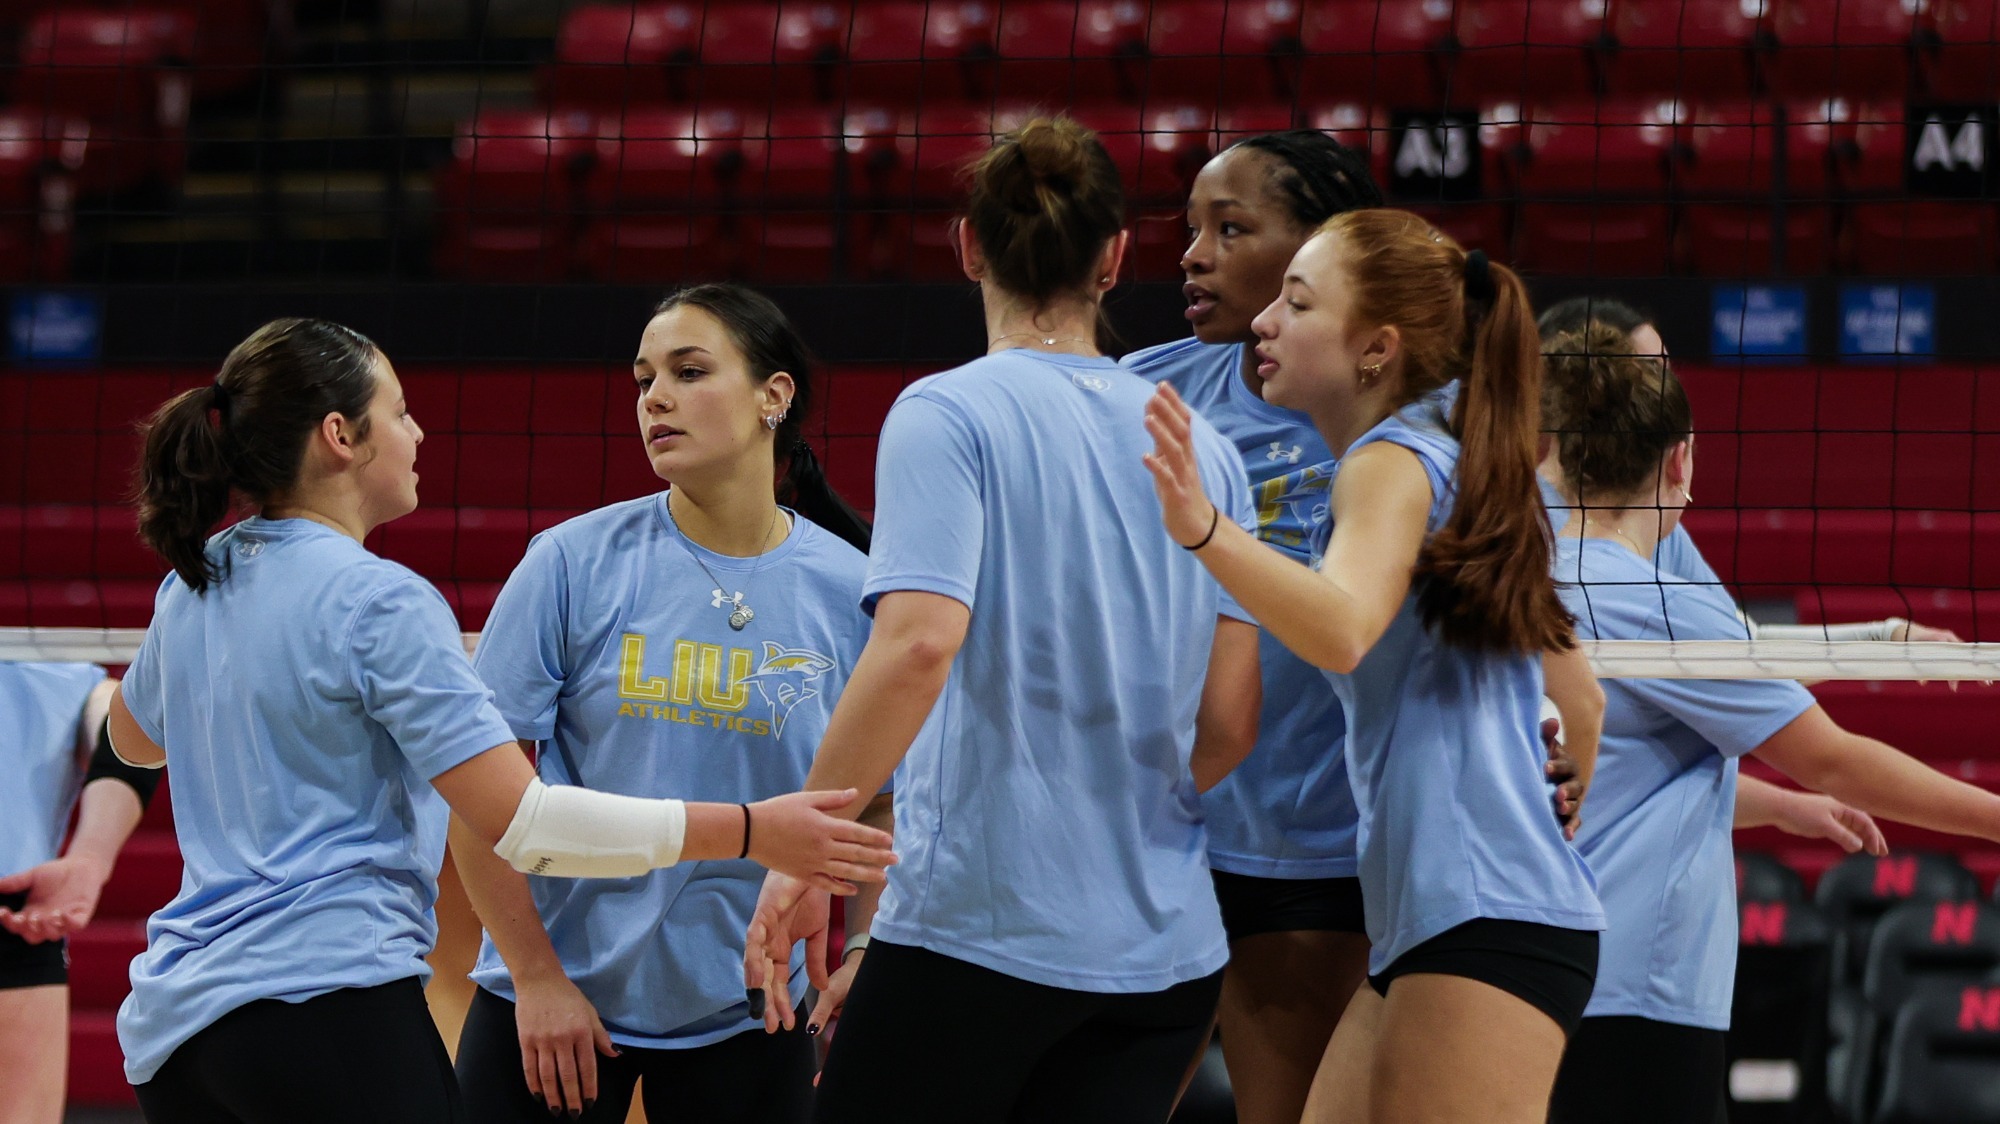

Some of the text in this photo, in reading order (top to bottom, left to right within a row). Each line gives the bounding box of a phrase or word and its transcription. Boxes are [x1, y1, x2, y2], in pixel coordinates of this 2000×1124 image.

[1396, 119, 1467, 177] A3
[1914, 113, 1984, 172] A4
[618, 633, 752, 713] LIU
[618, 702, 770, 736] ATHLETICS
[1873, 857, 1918, 896] N
[1741, 903, 1786, 945] N
[1932, 902, 1977, 943] N
[1958, 986, 2000, 1031] N
